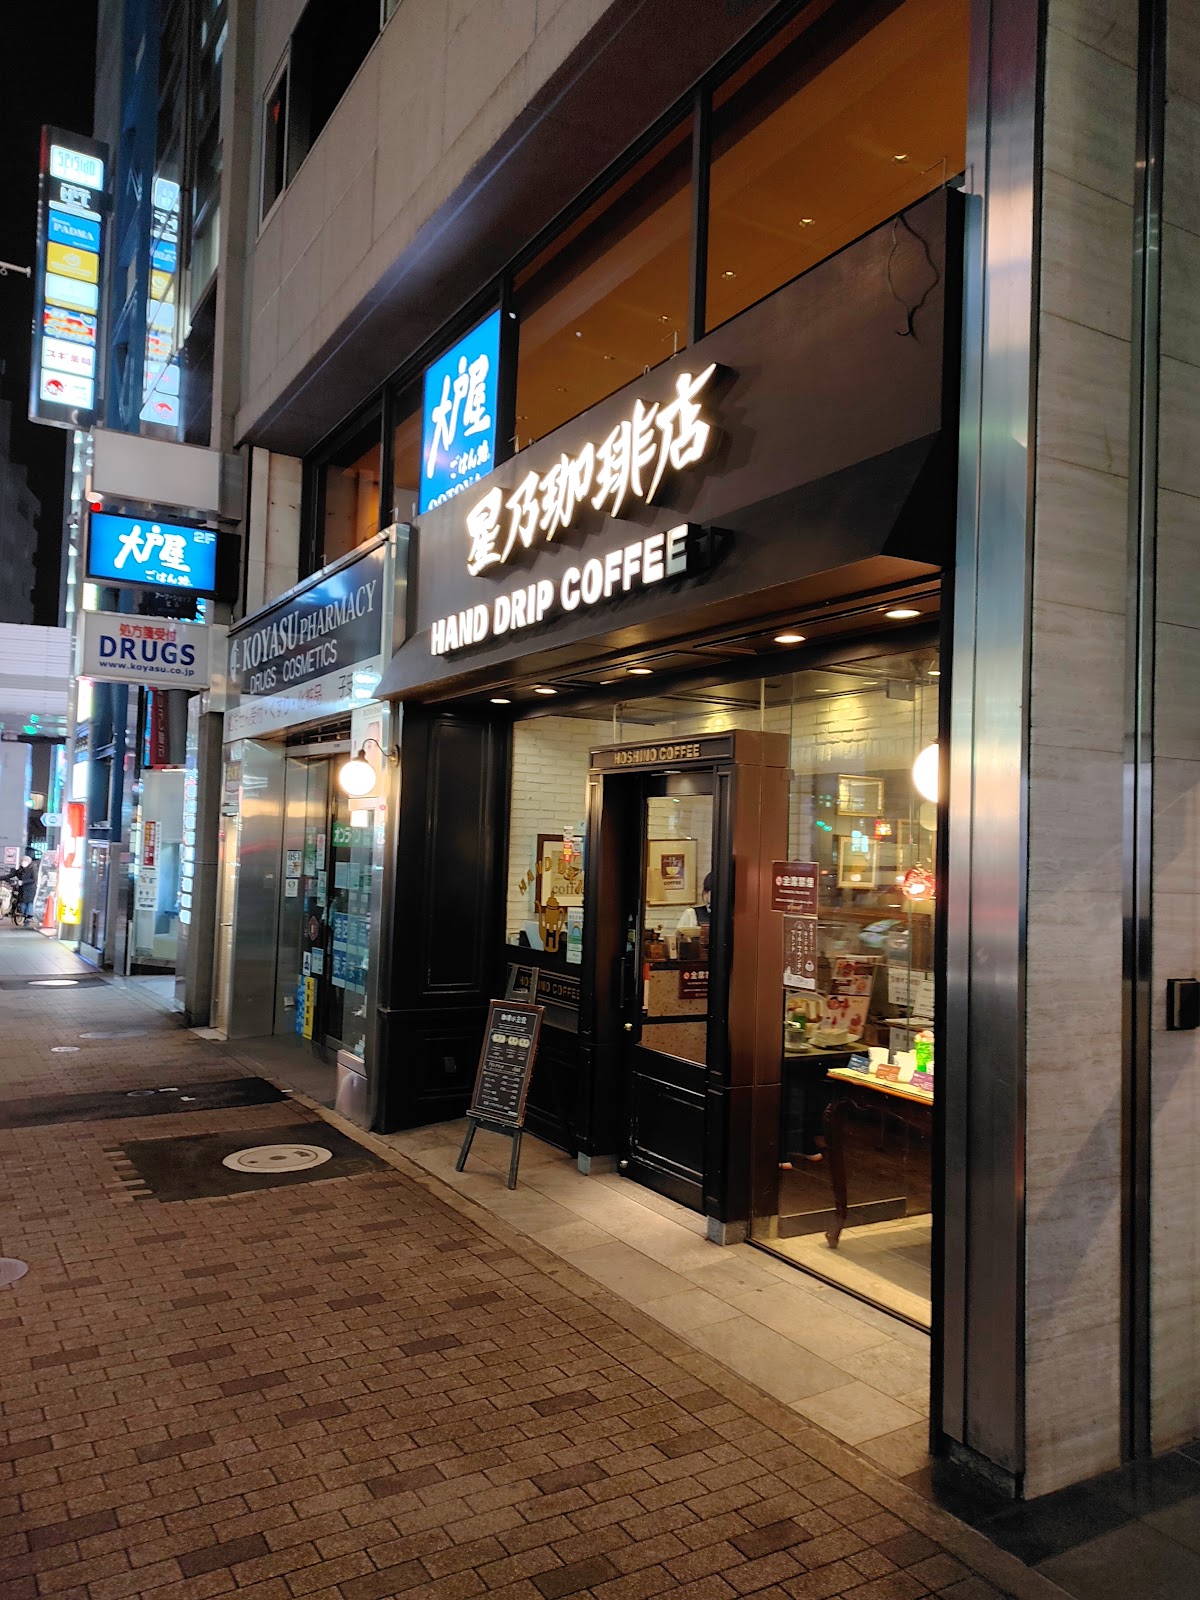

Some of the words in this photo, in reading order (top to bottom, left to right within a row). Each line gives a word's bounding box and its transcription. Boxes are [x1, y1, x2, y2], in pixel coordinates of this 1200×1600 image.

[426, 354, 491, 479] 大戸屋
[466, 363, 717, 577] 星乃珈琲店
[114, 524, 191, 572] 大戸屋
[193, 531, 216, 544] 2F
[431, 604, 490, 656] HAND
[493, 579, 555, 635] DRIP
[560, 523, 689, 611] COFFEE
[99, 635, 195, 666] DRUGS
[242, 611, 299, 671] KOYASU
[299, 579, 377, 645] PHARMACY
[99, 661, 195, 677] www.koyasu.co.jp
[250, 666, 277, 695] DRUGS
[283, 639, 338, 682] COSMETICS
[614, 748, 658, 764] HOSHINO
[659, 743, 700, 760] COFFEE
